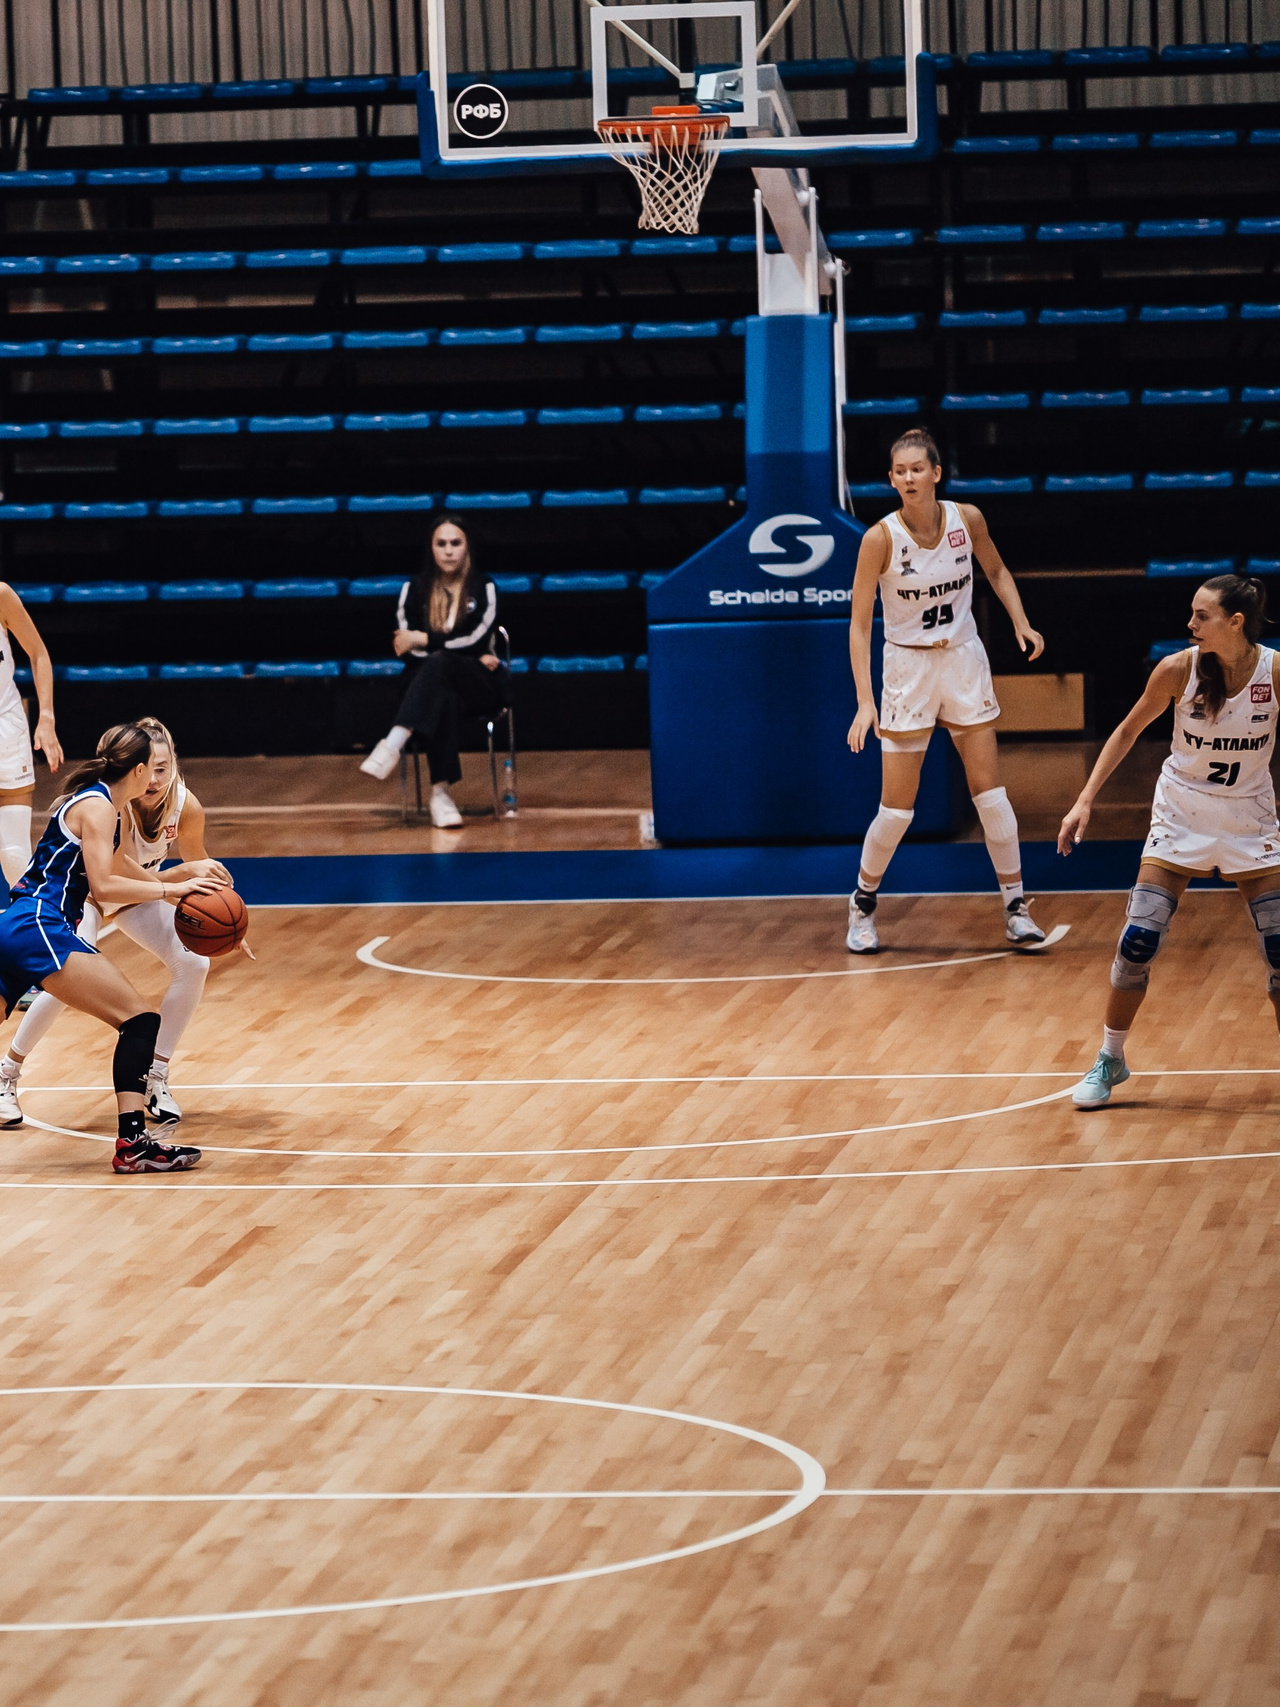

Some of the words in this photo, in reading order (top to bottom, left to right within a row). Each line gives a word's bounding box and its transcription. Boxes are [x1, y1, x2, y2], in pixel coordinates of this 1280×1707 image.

[461, 103, 502, 119] РФБ
[708, 588, 799, 606] Schelde
[803, 587, 877, 606] Spor
[1252, 692, 1269, 701] BET
[1207, 761, 1241, 786] 21
